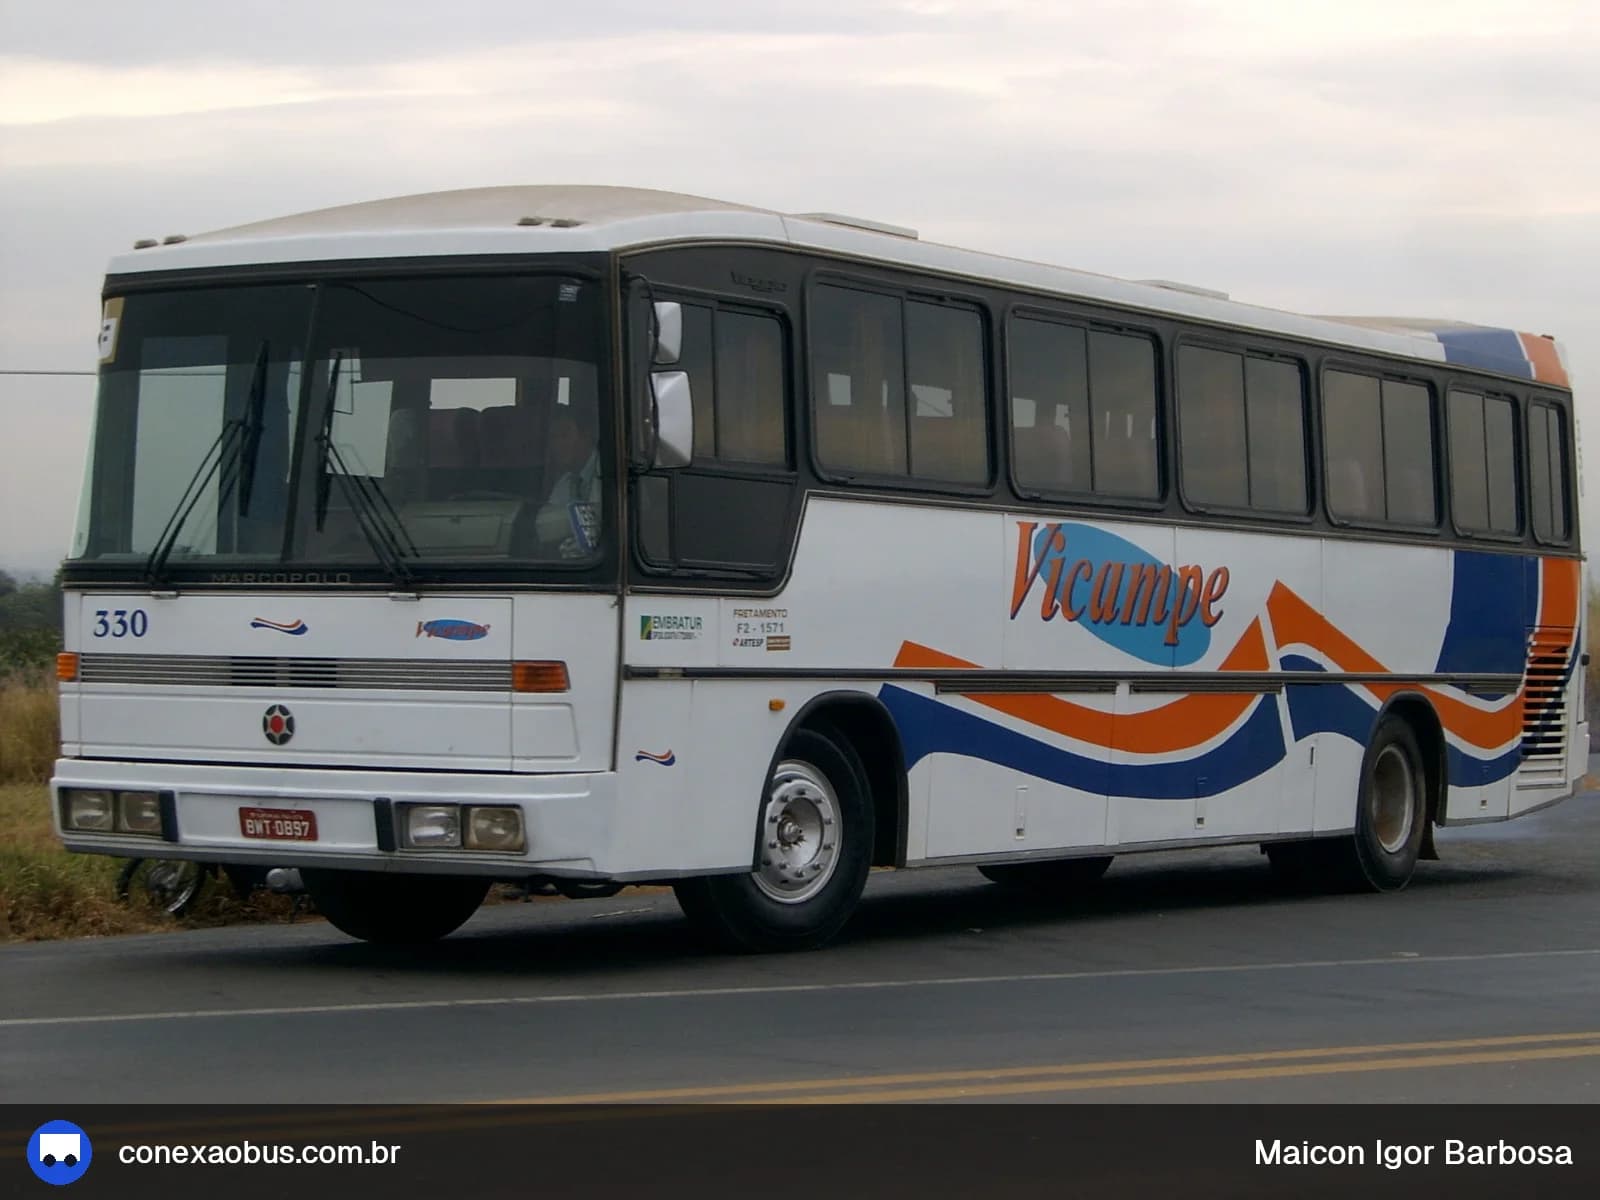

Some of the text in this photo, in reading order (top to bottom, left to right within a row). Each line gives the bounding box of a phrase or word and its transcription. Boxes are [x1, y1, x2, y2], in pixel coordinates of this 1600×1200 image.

[210, 572, 352, 584] MARCOPOLO
[1009, 520, 1230, 646] Vicampe
[733, 608, 788, 619] FRETAMENTO
[93, 609, 148, 638] 330
[653, 616, 702, 630] EMBRATUR
[737, 623, 750, 634] F2
[761, 622, 784, 633] 1571
